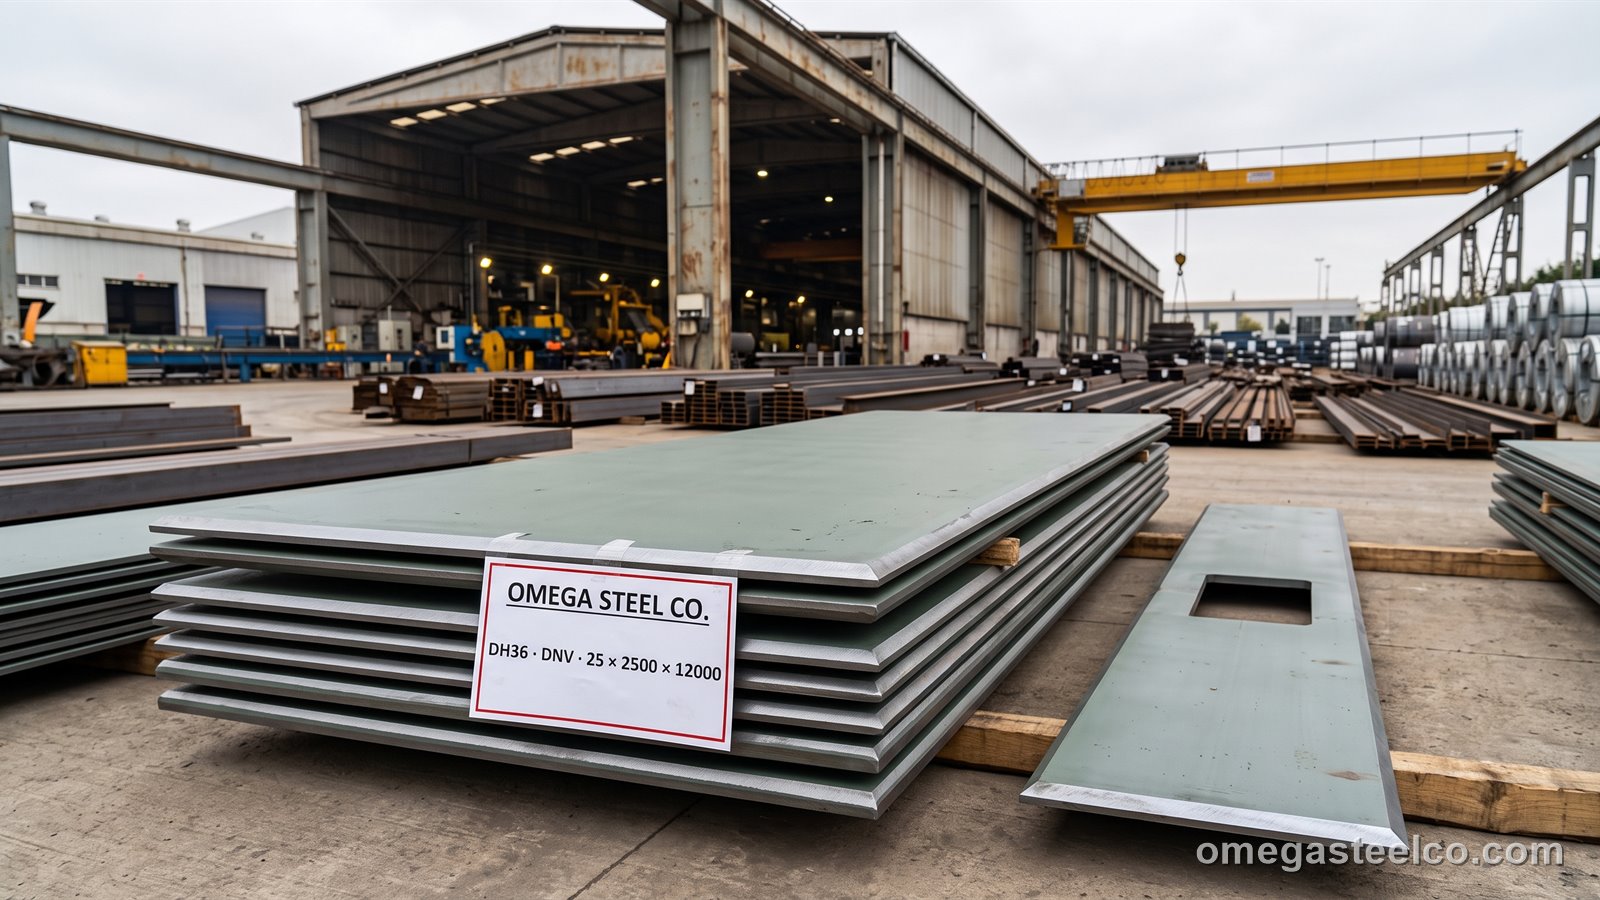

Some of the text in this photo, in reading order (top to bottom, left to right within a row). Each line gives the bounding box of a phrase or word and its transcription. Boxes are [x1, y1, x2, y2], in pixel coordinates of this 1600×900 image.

[507, 582, 709, 621] OMEGA STEEL CO.
[488, 642, 529, 659] DH36
[541, 647, 574, 664] DNV
[586, 651, 604, 668] 25
[621, 655, 658, 674] 2500
[675, 662, 722, 682] 12000
